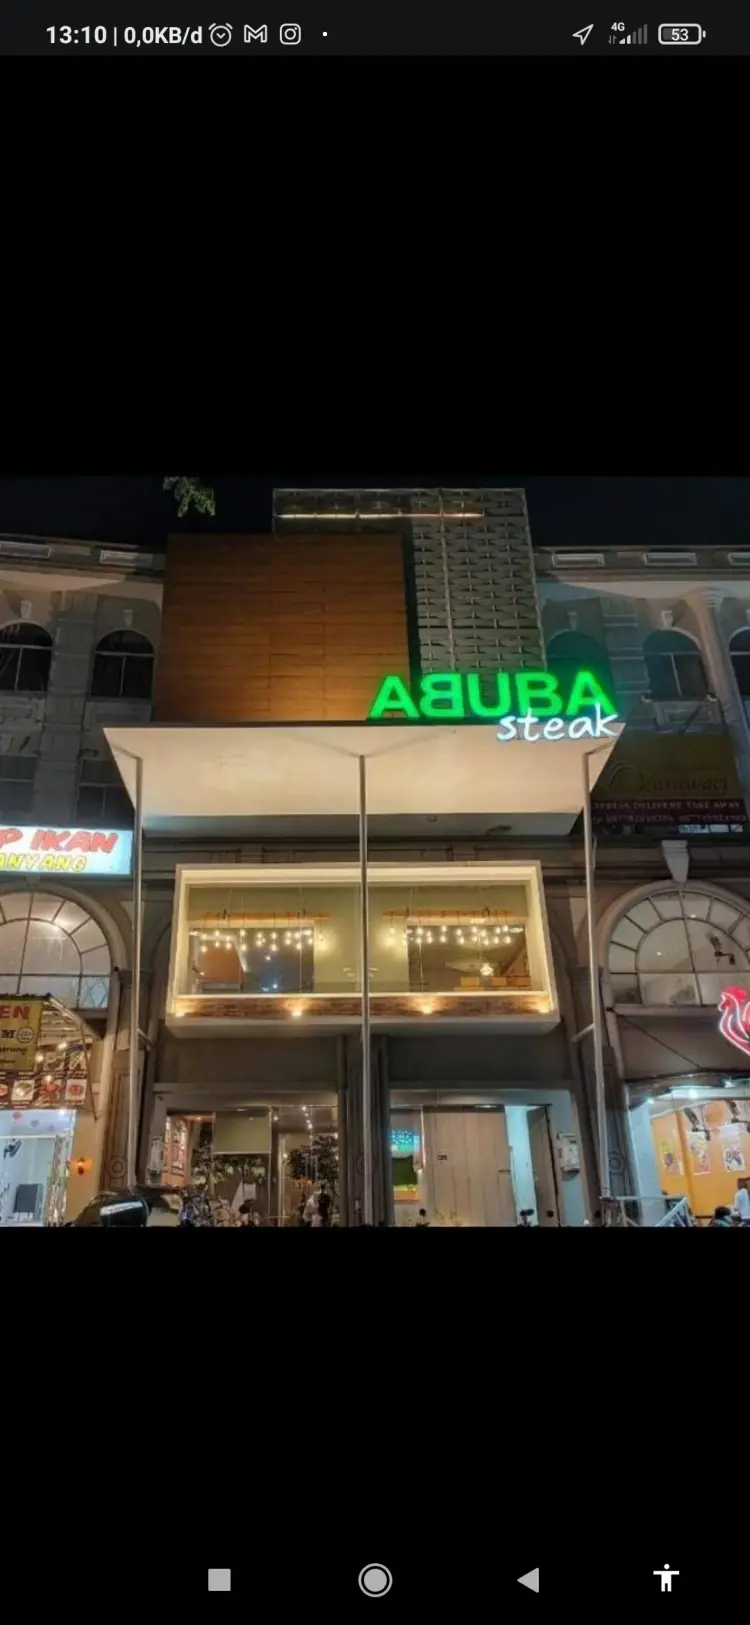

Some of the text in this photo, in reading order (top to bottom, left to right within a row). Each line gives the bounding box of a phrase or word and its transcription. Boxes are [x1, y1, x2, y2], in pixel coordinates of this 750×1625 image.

[369, 671, 616, 718] ABUBA
[496, 702, 619, 742] steak
[30, 828, 119, 854] IKAN
